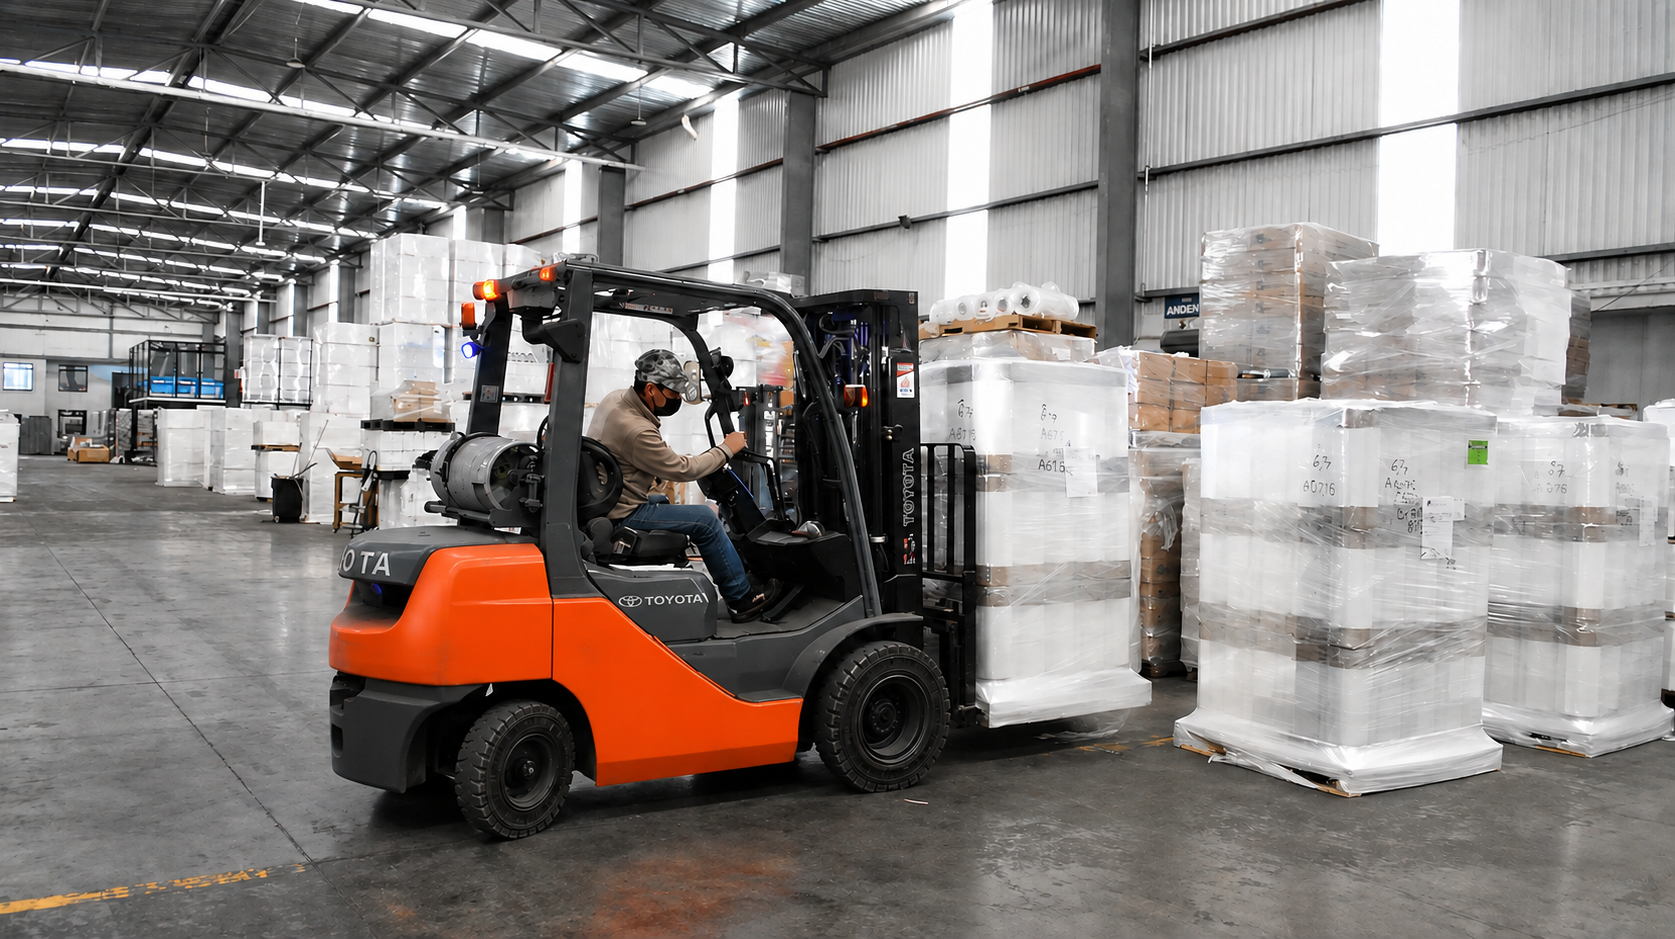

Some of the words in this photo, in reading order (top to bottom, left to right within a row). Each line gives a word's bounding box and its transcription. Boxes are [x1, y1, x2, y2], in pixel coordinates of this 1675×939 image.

[1166, 303, 1199, 316] ANDEN
[902, 447, 915, 527] TOYOTA
[342, 548, 391, 577] OTA
[644, 594, 703, 606] TOYOTA
